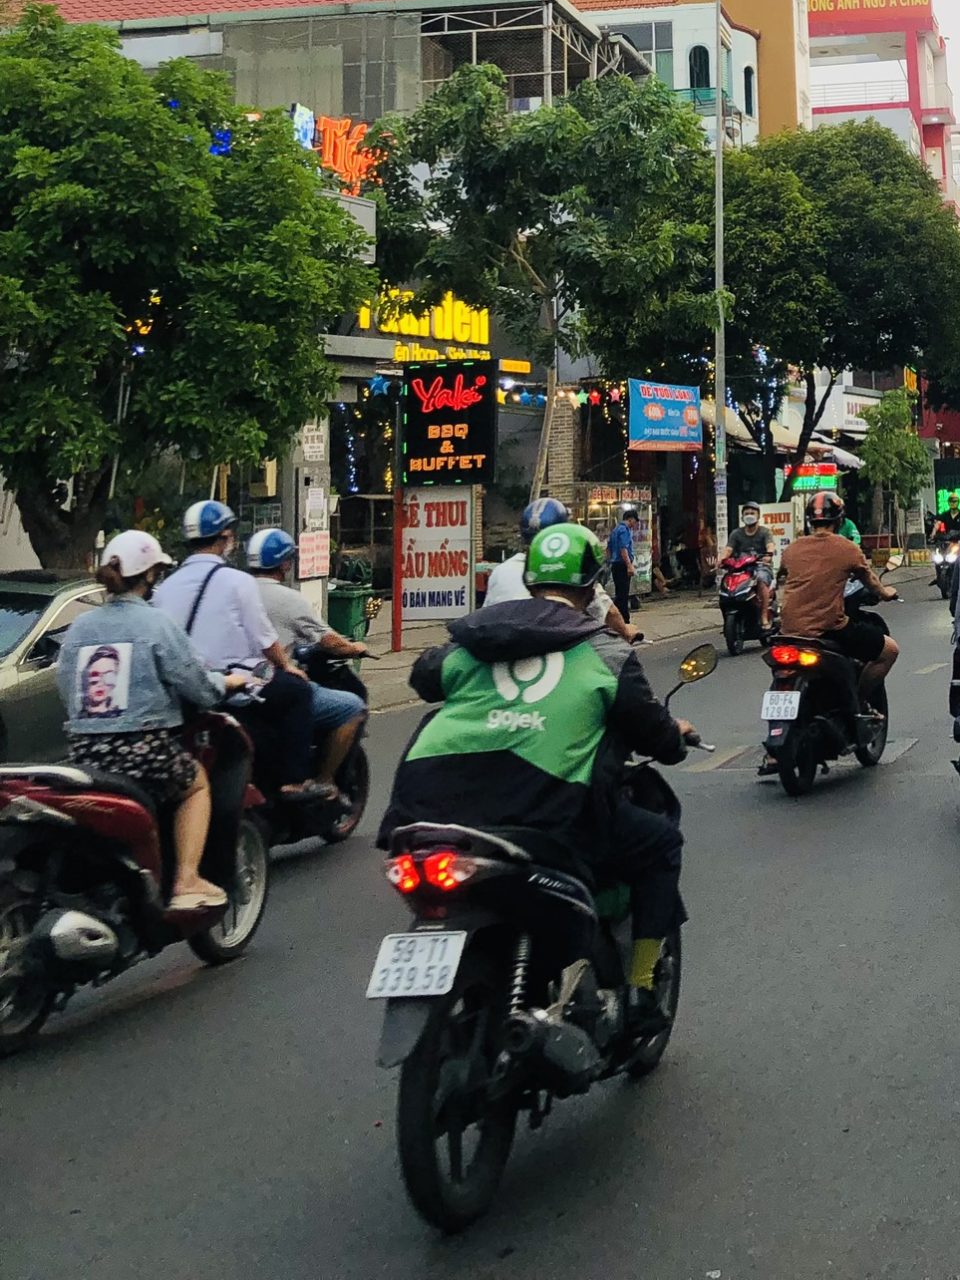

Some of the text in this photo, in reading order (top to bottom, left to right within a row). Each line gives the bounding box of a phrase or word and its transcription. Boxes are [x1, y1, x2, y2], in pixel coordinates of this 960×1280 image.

[412, 374, 486, 413] Yaki
[428, 424, 468, 439] BBQ
[440, 440, 454, 453] &
[409, 454, 486, 471] BUFFET
[424, 501, 467, 528] THUI
[409, 588, 426, 608] BÁN
[428, 590, 453, 607] MANG
[486, 708, 547, 732] gojek
